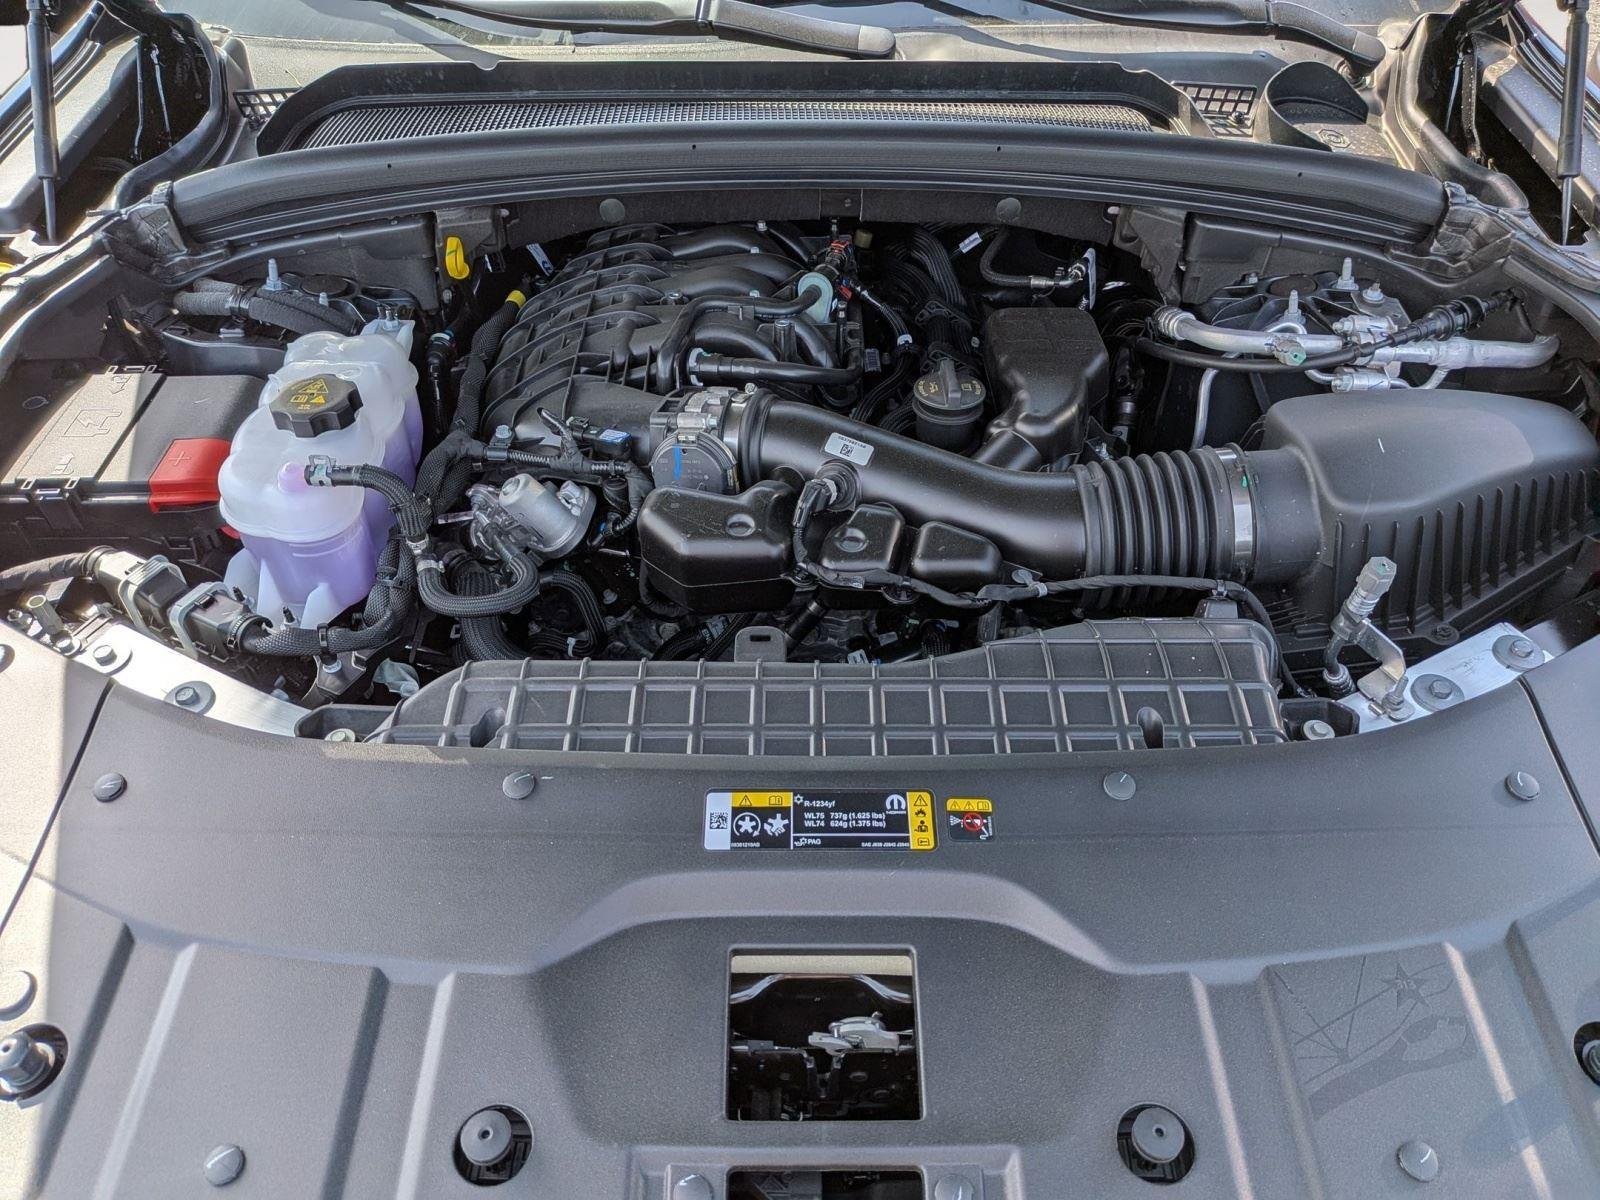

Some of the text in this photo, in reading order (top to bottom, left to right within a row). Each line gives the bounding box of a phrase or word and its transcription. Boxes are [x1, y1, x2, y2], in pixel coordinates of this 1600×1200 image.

[803, 800, 836, 809] R-1234yf
[829, 812, 848, 820] 737g
[848, 812, 871, 820] (1.625
[871, 812, 886, 820] lbs)
[829, 820, 848, 828] 624g
[848, 820, 871, 828] (1.375
[871, 820, 886, 828] lbs)
